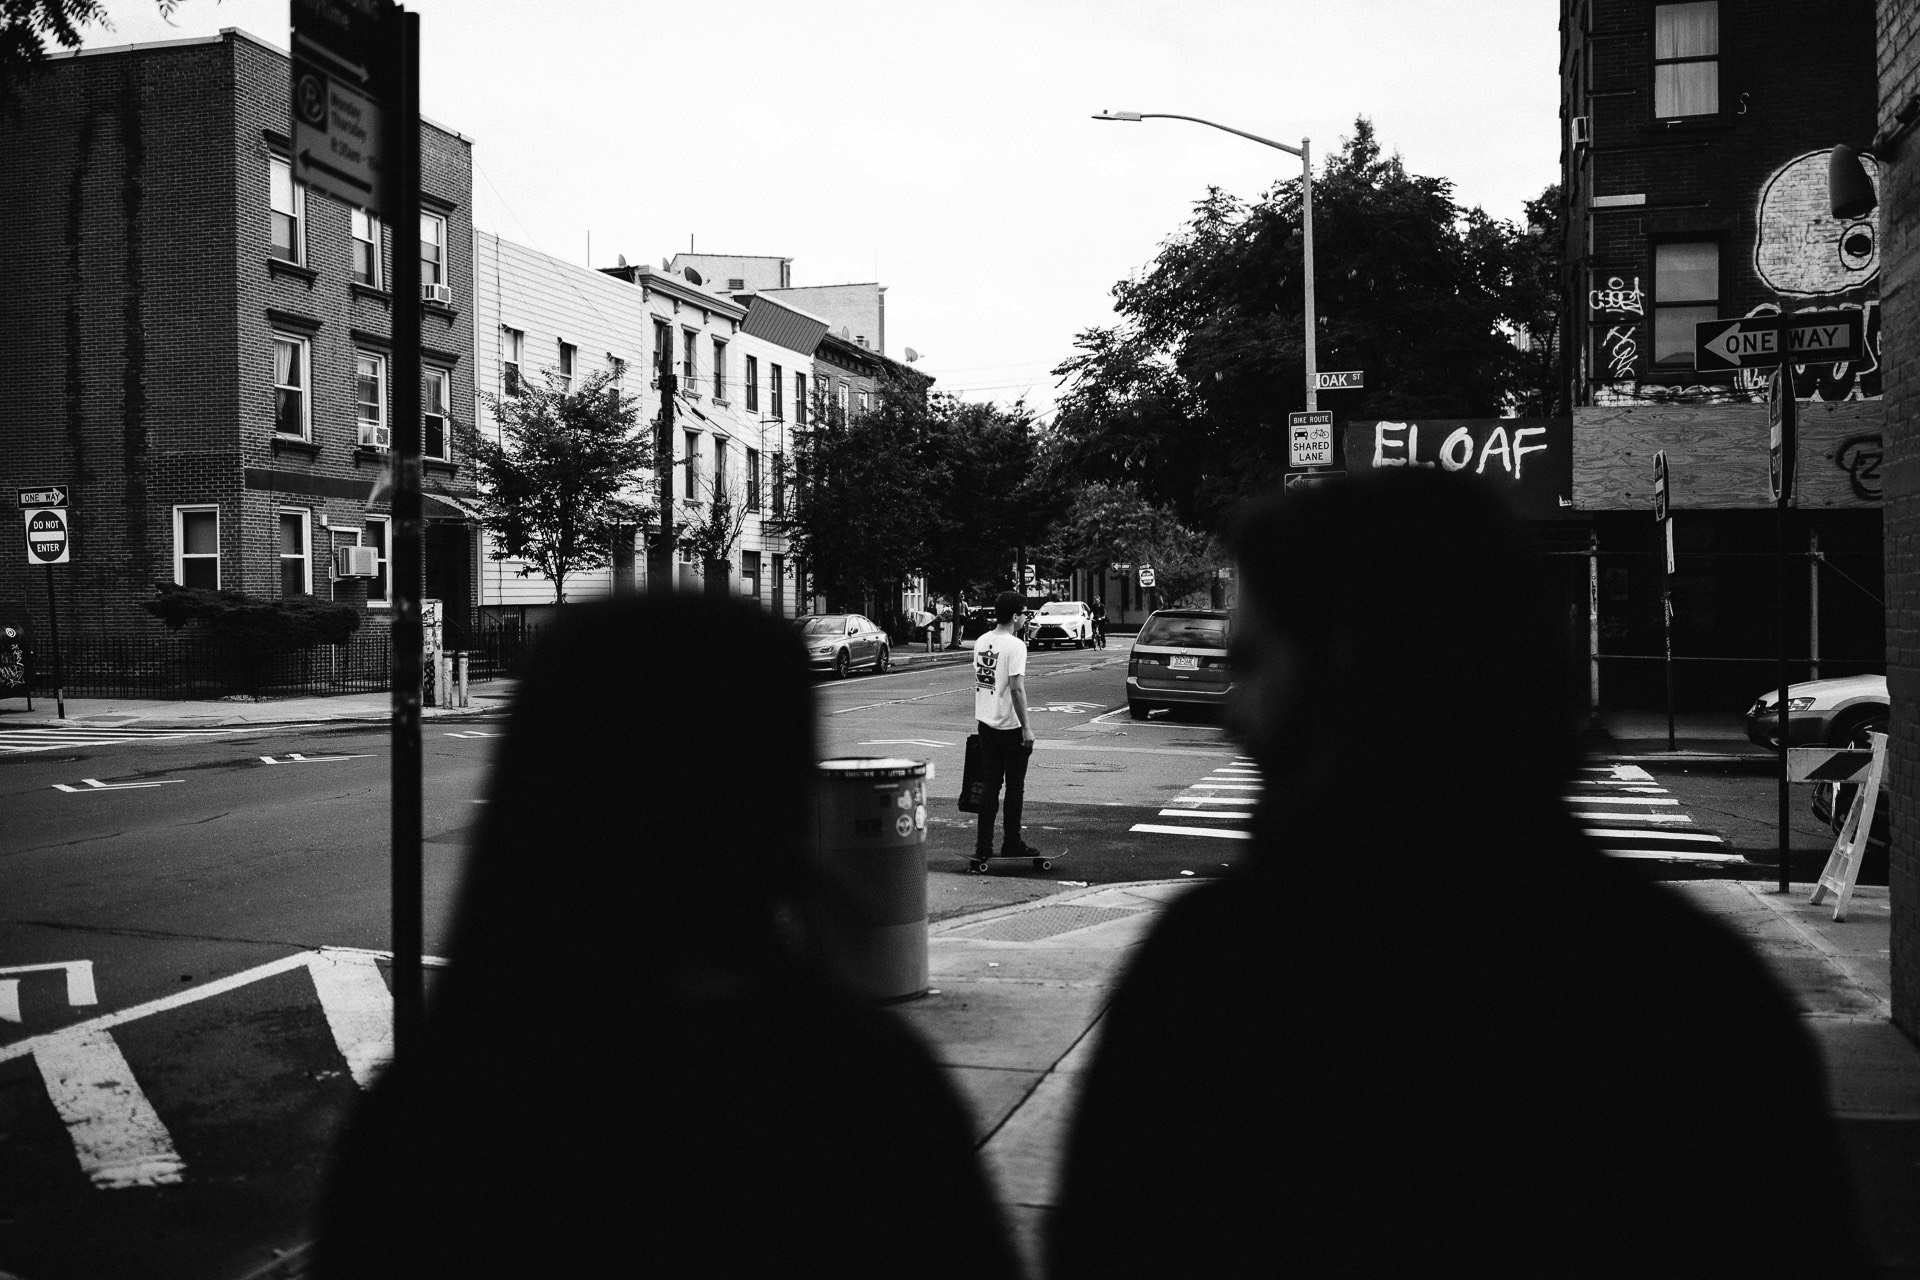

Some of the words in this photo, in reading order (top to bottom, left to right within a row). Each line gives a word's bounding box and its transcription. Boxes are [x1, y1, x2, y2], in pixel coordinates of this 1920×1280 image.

[1726, 332, 1774, 354] ONE
[1787, 327, 1839, 349] WAY
[1321, 374, 1347, 387] OAK
[1309, 415, 1329, 423] ROUTE
[1293, 441, 1330, 451] SHARED
[1299, 452, 1324, 462] LANE
[24, 494, 39, 502] ONE
[45, 493, 60, 502] WAY
[33, 520, 44, 530] DO
[46, 520, 59, 529] NOT
[37, 543, 60, 553] ENTER
